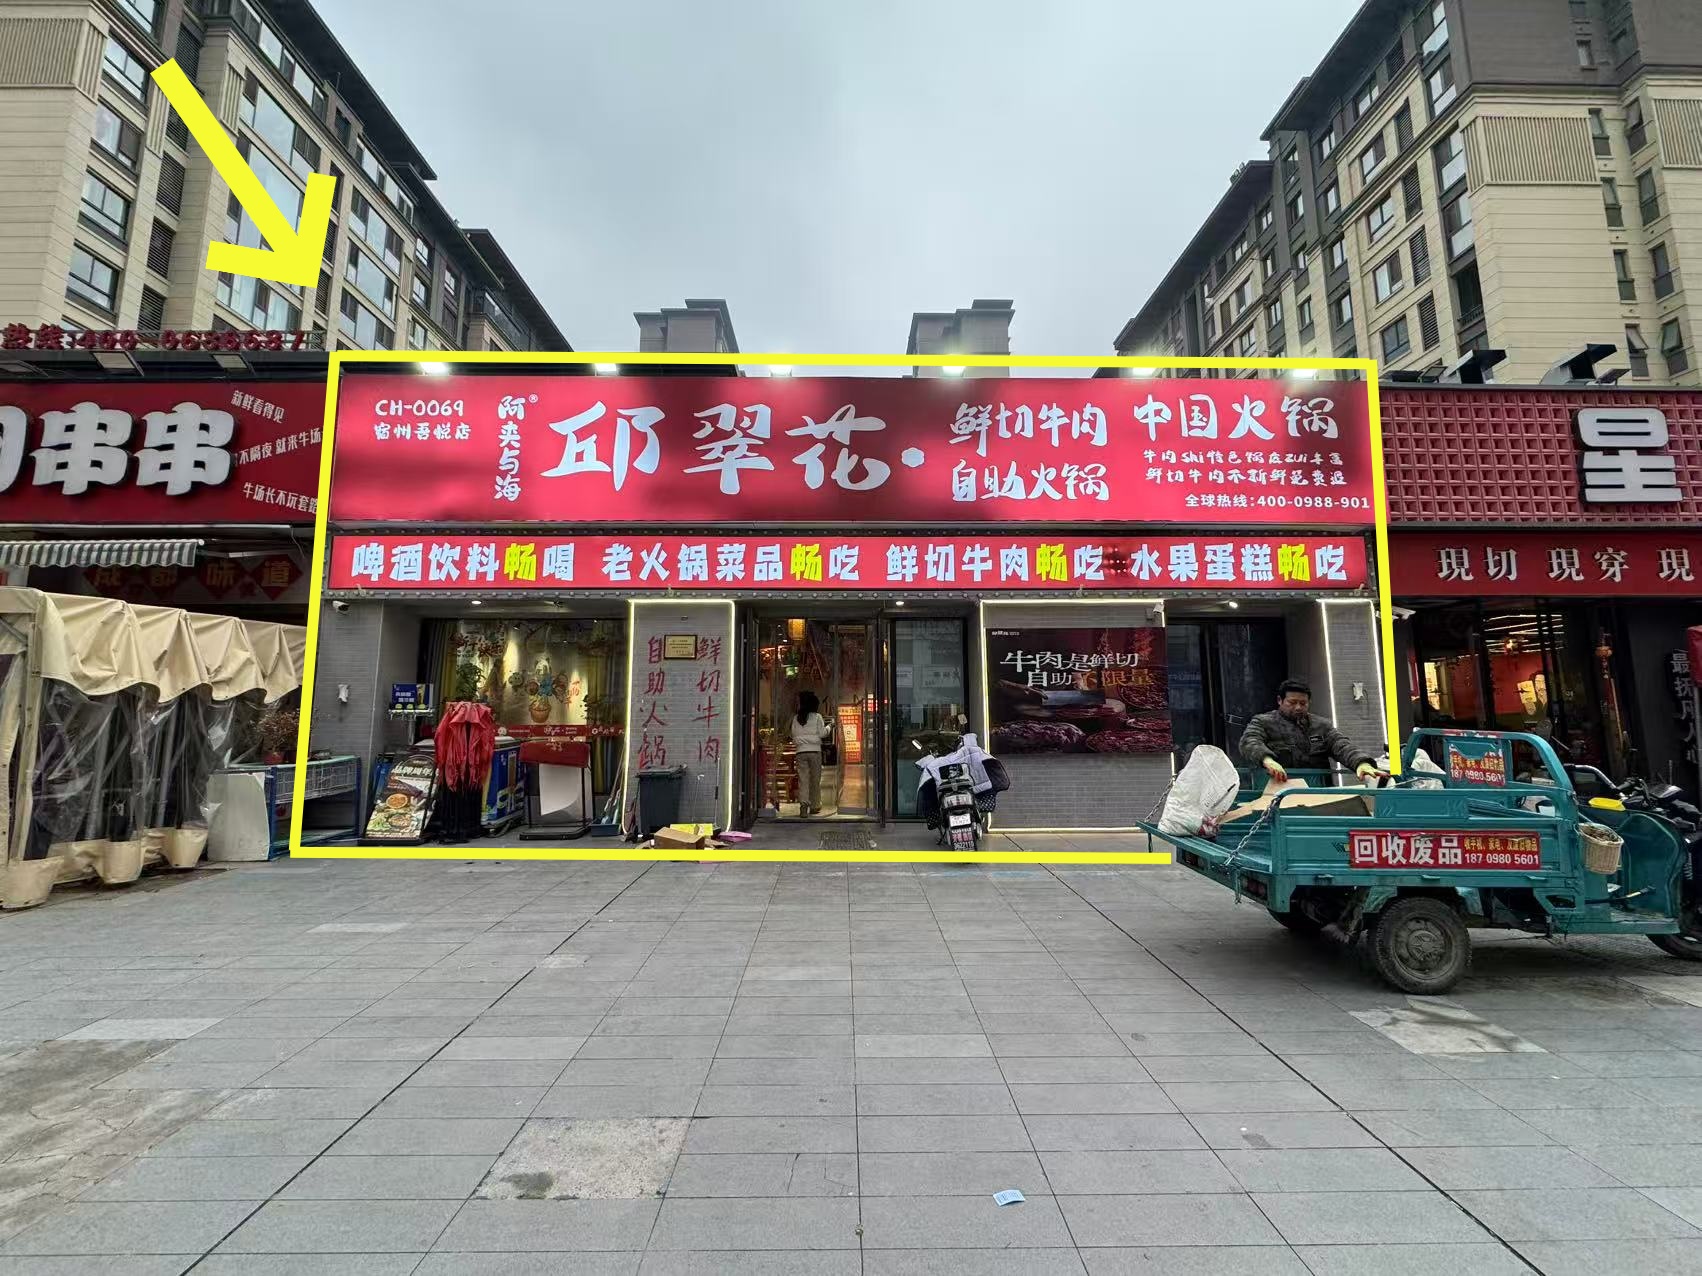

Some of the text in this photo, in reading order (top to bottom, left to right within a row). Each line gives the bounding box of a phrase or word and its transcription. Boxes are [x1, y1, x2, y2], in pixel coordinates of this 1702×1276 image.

[231, 390, 285, 423] 新鲜看得见
[375, 400, 464, 416] CH-0069
[1134, 393, 1338, 440] 中国火锅
[374, 422, 471, 440] 宿州吾悦店
[949, 402, 1108, 458] 鲜切牛肉
[951, 459, 1110, 501] 自助火锅
[351, 542, 1348, 582] 啤酒饮料畅喝 老火锅菜品畅吃 鲜切牛肉畅吃 水果蛋糕畅吃
[1437, 547, 1695, 583] 現切 現穿 現
[1000, 650, 1139, 672] 牛肉是鲜切
[1027, 668, 1155, 690] 自助不限量
[637, 635, 671, 771] 自助火锅
[692, 635, 722, 765] 鲜切牛肉
[1354, 833, 1463, 865] 回收废品
[1465, 853, 1539, 865] 187 0980 5601
